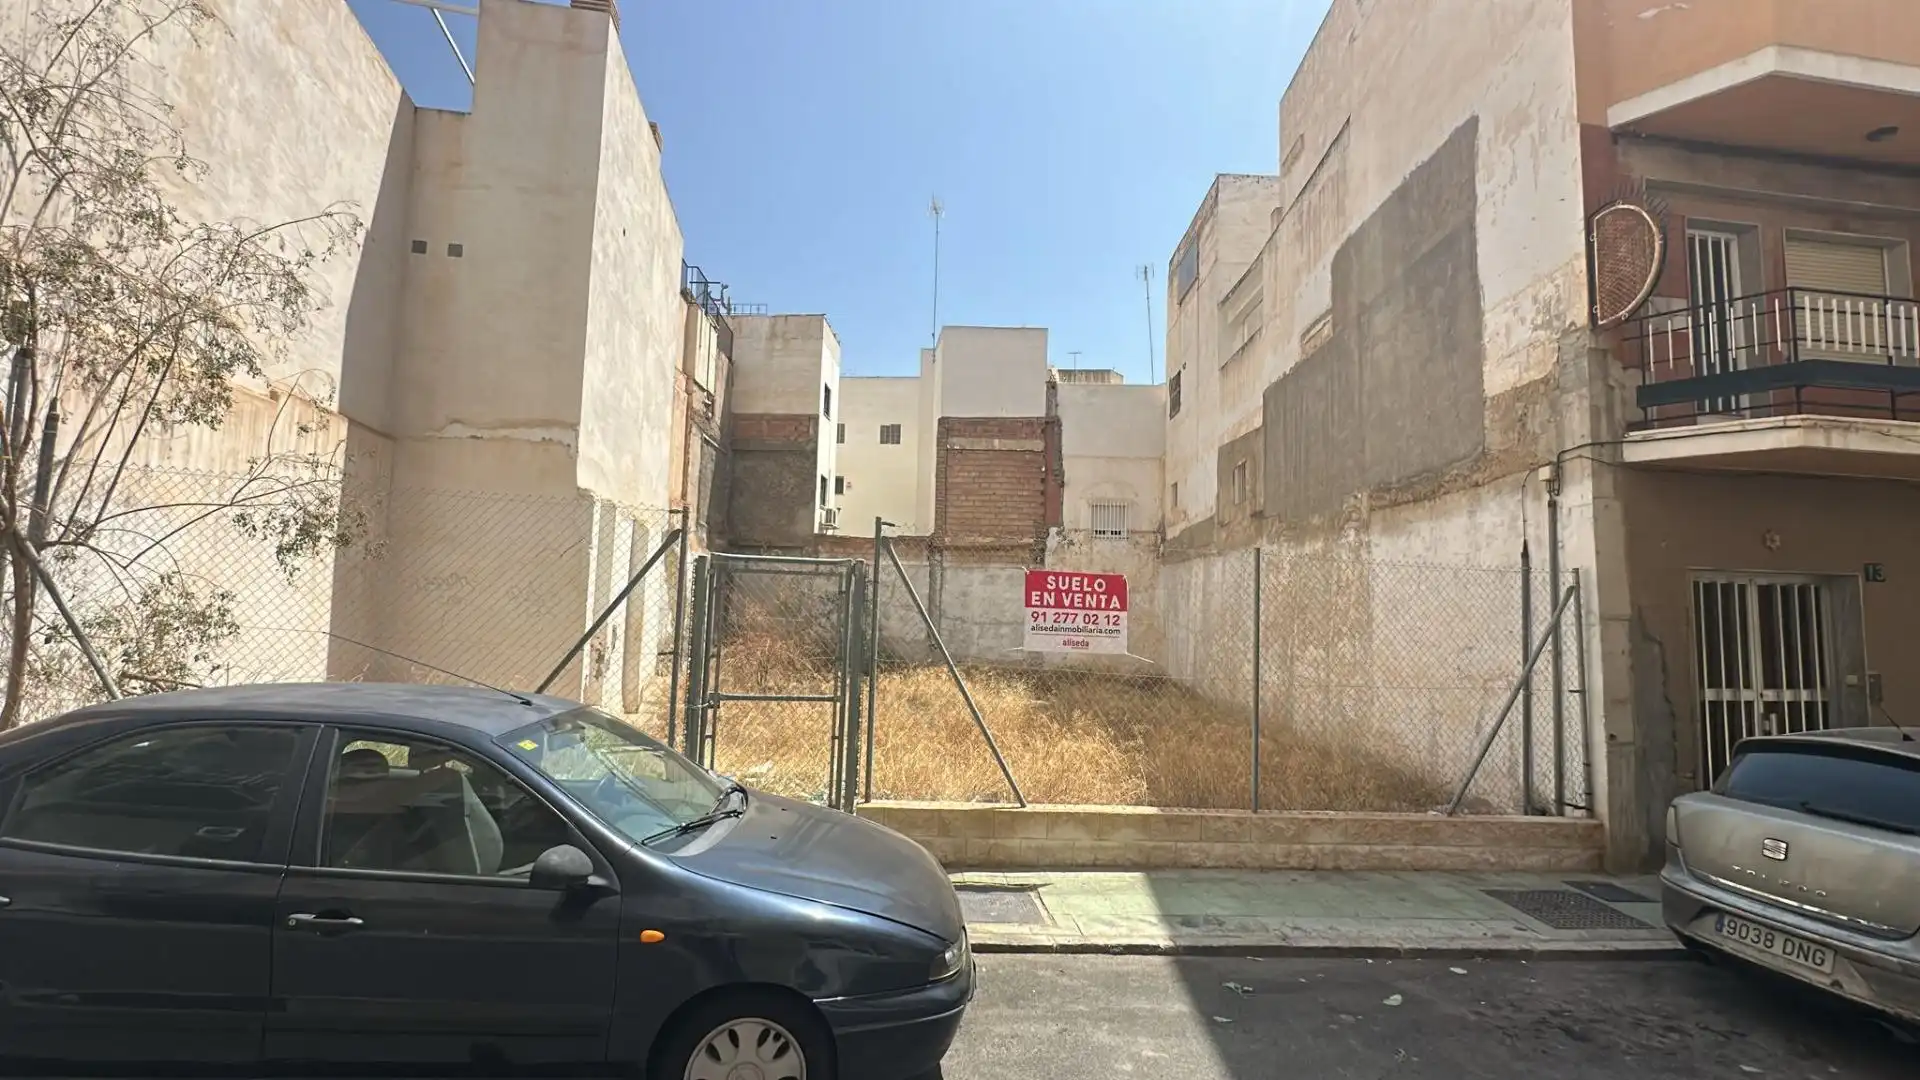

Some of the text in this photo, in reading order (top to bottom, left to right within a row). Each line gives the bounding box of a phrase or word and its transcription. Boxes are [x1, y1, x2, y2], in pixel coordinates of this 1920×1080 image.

[1868, 564, 1885, 581] 13
[1046, 575, 1106, 592] SUELO
[1031, 591, 1121, 609] EN VENTA
[1031, 611, 1120, 626] 91 277 02 12
[1031, 623, 1121, 635] alisedainmobiliaria.com
[1062, 638, 1090, 647] aliseda
[1726, 918, 1826, 967] 9038 DNG
